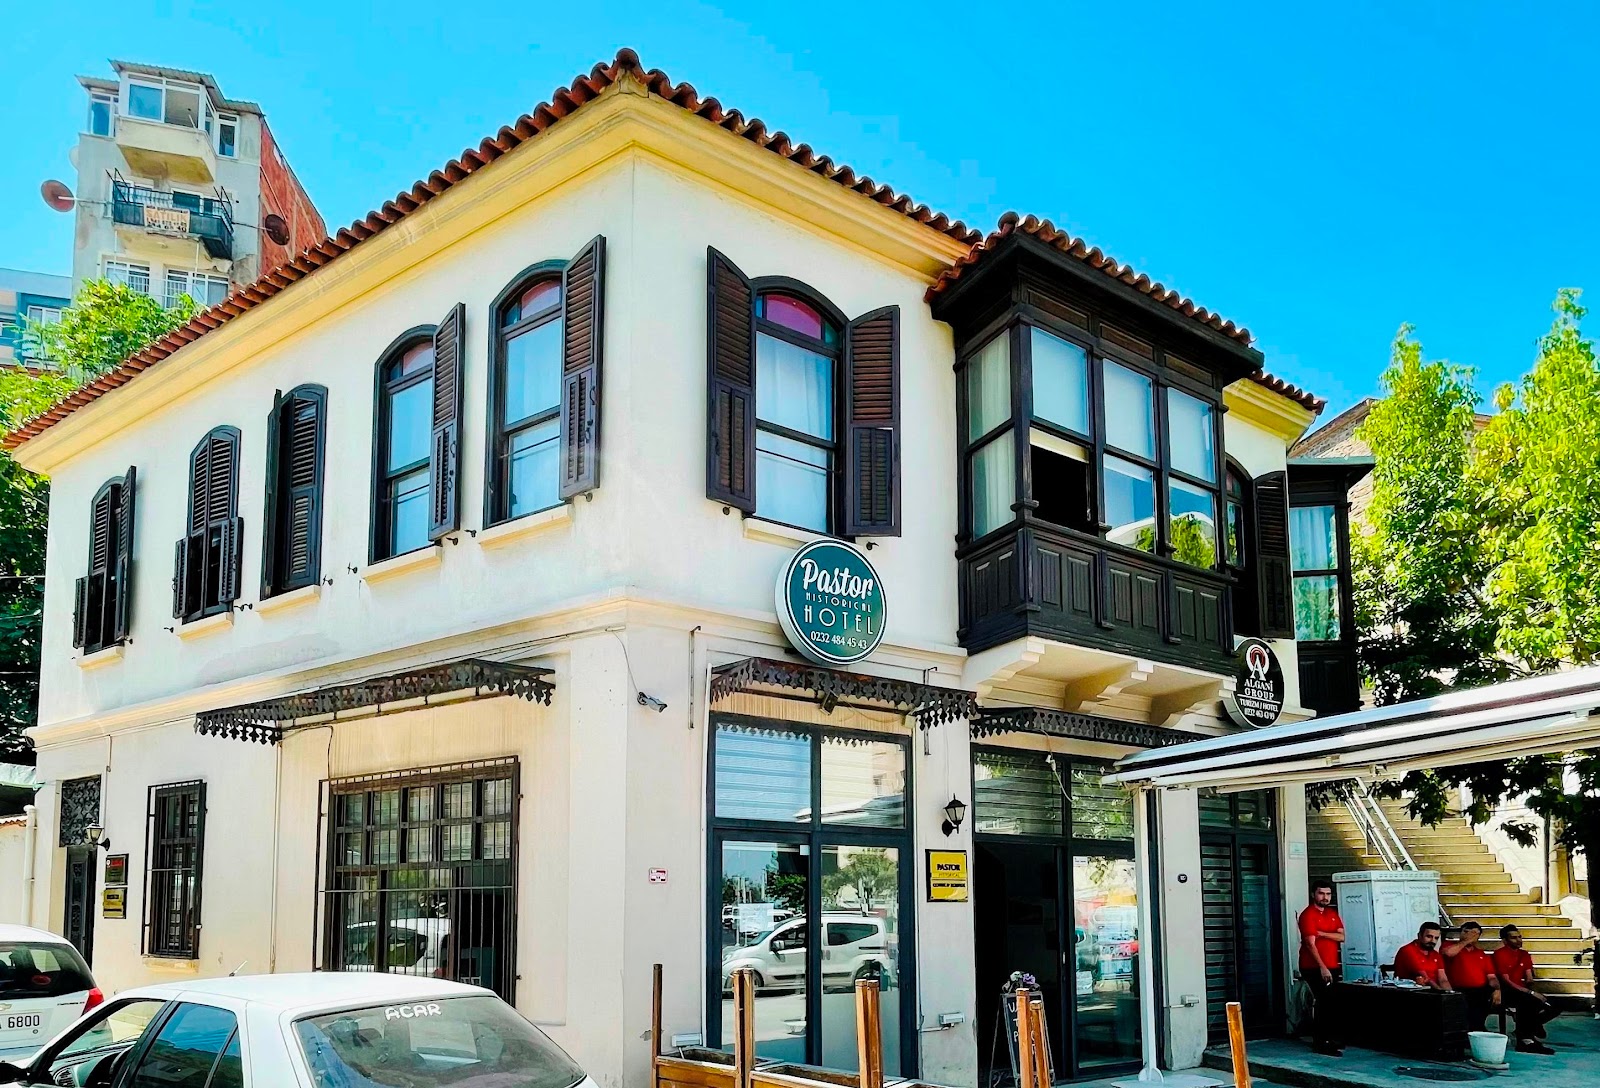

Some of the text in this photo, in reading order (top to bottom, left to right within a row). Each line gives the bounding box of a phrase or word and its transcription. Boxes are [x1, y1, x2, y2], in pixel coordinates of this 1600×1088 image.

[800, 558, 874, 600] Pastor
[805, 592, 872, 613] HISTORICAL
[804, 604, 873, 635] HOTEL
[810, 630, 868, 650] 0232 484 45 43
[1245, 688, 1275, 700] GROUP
[936, 863, 961, 872] PASTOR
[7, 1014, 40, 1029] 6800
[384, 1003, 442, 1021] ACAR
